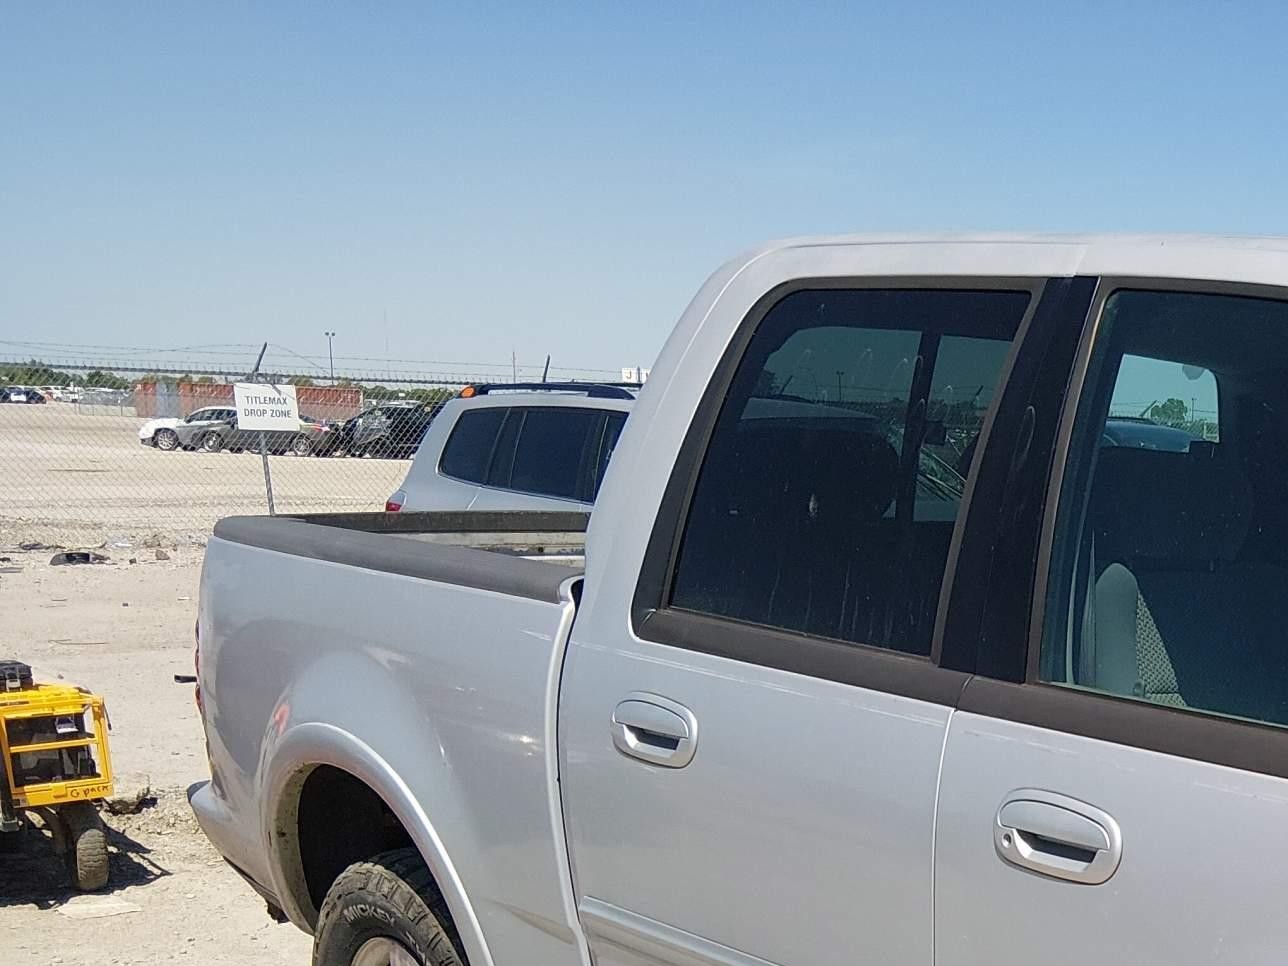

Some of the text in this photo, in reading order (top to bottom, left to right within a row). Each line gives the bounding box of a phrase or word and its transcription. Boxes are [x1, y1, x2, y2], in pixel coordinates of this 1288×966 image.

[245, 396, 288, 405] TITLEMAX
[244, 408, 292, 418] DROP ZONE
[343, 904, 395, 927] MICKEY
